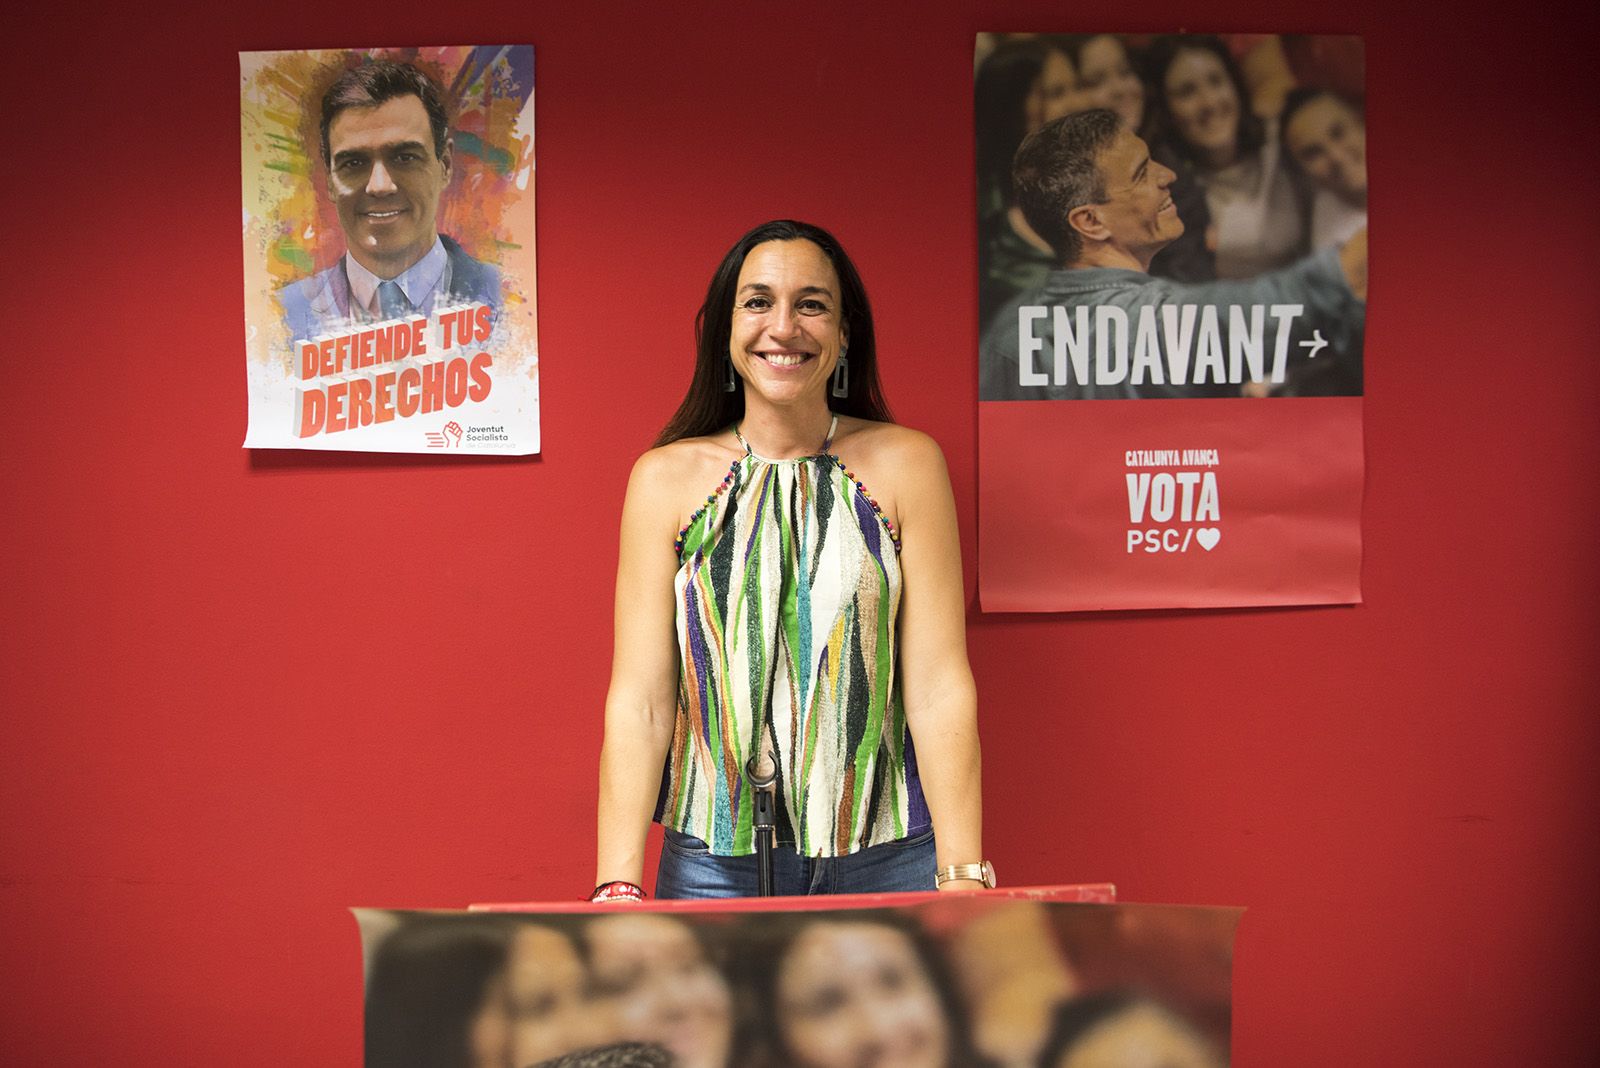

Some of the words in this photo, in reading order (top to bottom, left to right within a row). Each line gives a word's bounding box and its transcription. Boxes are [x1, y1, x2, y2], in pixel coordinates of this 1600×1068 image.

[296, 315, 428, 382] DEFIENDE
[434, 303, 492, 350] TUS
[1018, 304, 1304, 387] ENDAVANT
[294, 352, 494, 439] DERECHOS
[466, 433, 509, 442] Socialista
[467, 425, 504, 433] Joventut
[1125, 449, 1181, 467] CATALUNYA
[1182, 448, 1220, 468] AVANÇA
[1125, 471, 1220, 523] VOTA
